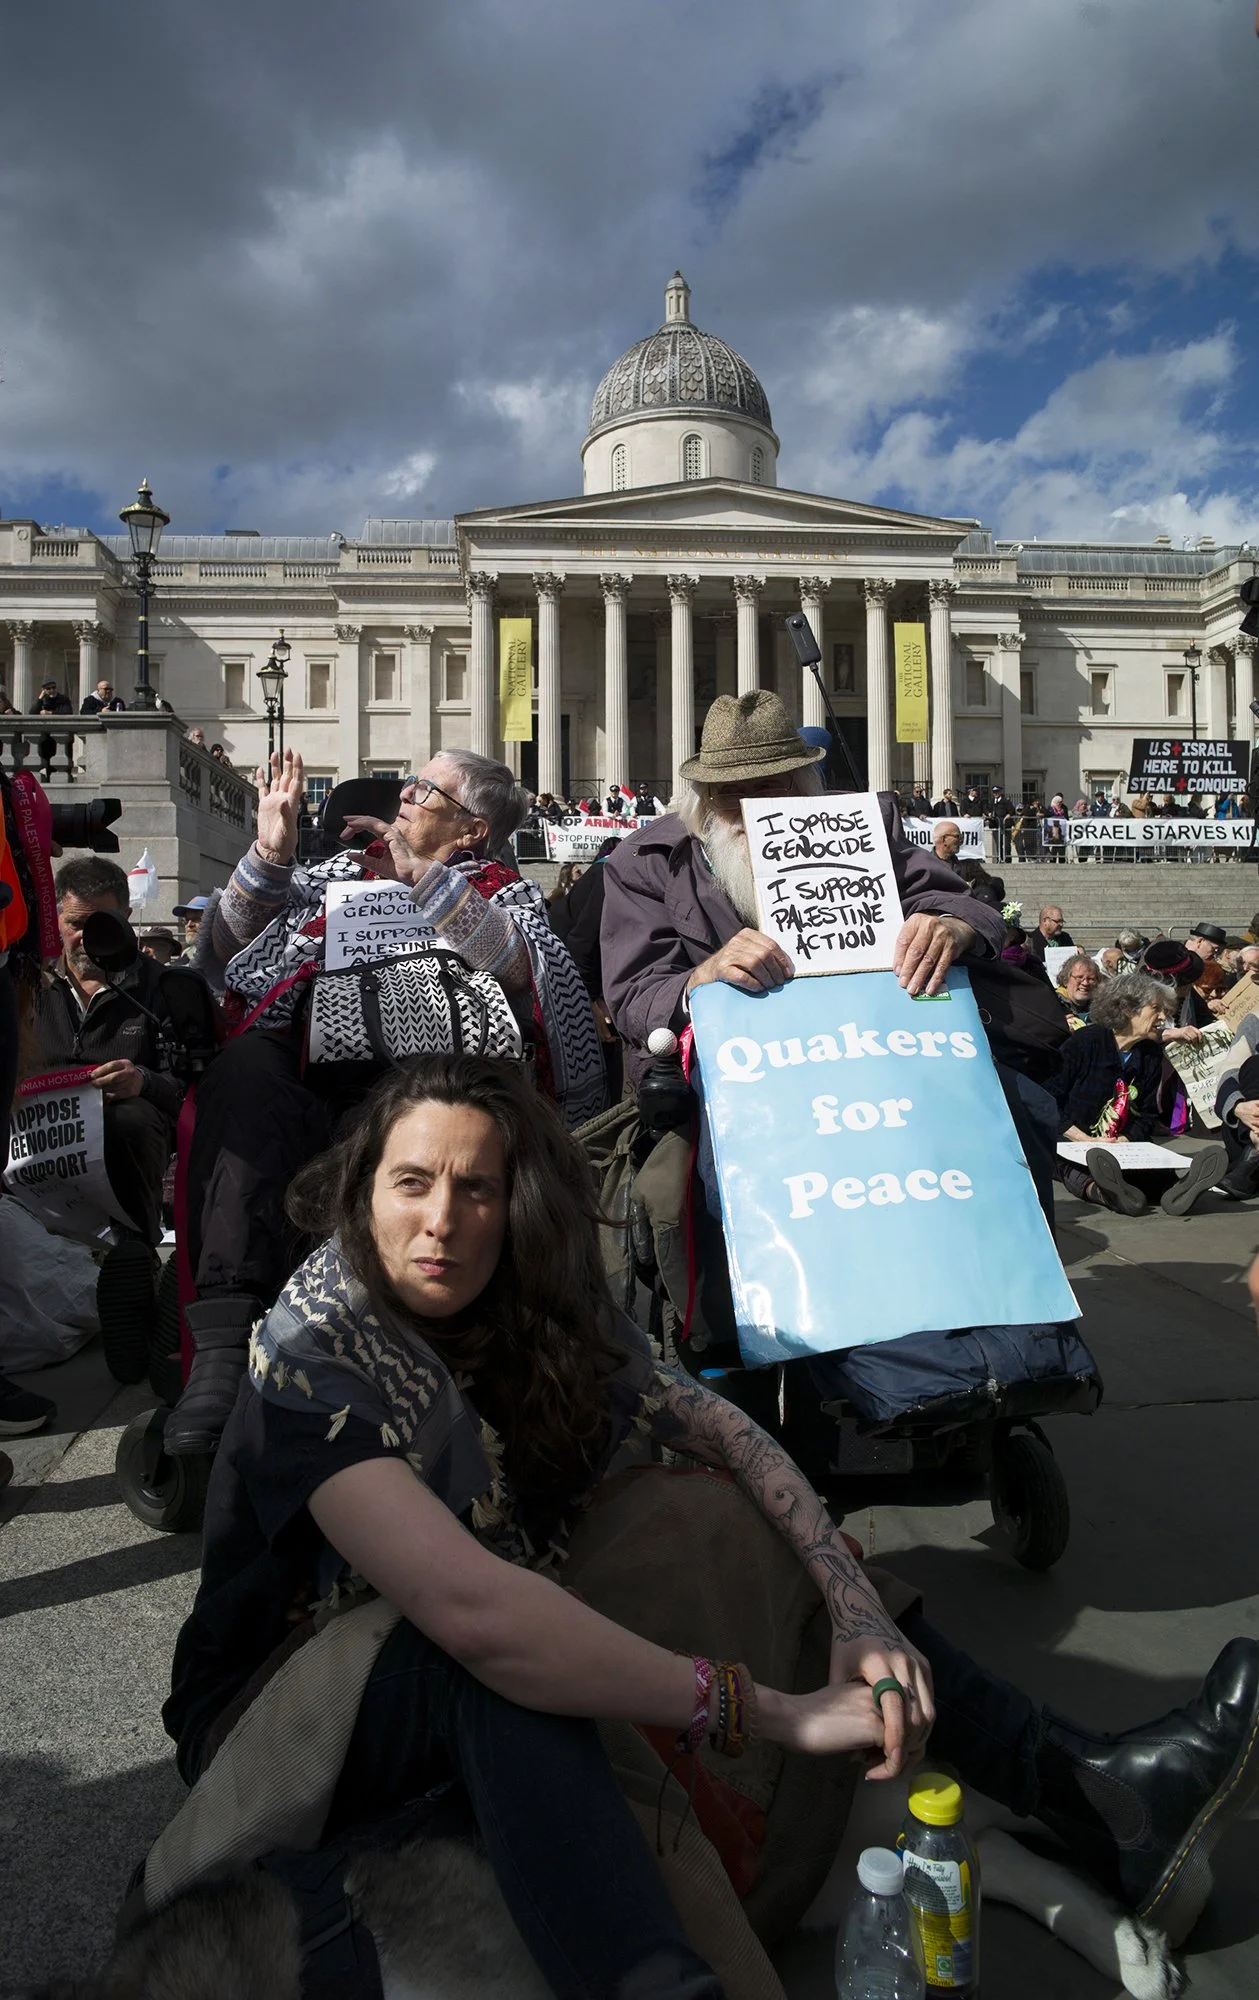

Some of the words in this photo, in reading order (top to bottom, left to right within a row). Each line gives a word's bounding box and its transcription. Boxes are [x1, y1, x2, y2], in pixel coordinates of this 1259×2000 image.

[577, 543, 617, 556] THE
[631, 544, 742, 558] NATIONAL
[757, 548, 850, 560] GALLERY
[508, 638, 516, 697] NATIONAL
[517, 639, 527, 697] GALLERY
[904, 641, 912, 697] NATIONAL
[913, 642, 923, 698] GALLERY
[1182, 742, 1232, 757] ISRAEL
[1142, 760, 1178, 774] HERE
[1183, 760, 1199, 774] TO
[1202, 761, 1236, 775] KILL
[1130, 777, 1175, 791] STEAL
[1187, 778, 1246, 793] CONQUER
[548, 817, 583, 827] STOP
[584, 818, 638, 829] ARMING
[757, 812, 785, 837] I
[789, 810, 869, 836] OPPOSE
[904, 830, 933, 845] HOL
[1068, 825, 1136, 840] ISRAEL
[1142, 826, 1227, 840] STARVES
[1232, 826, 1251, 840] KI
[558, 834, 583, 843] STOP
[573, 842, 588, 850] END
[762, 833, 875, 862] GENOCIDE
[14, 778, 27, 806] FREE
[21, 806, 48, 880] PALESTINIAN
[42, 882, 56, 950] HOSTAGES
[341, 894, 353, 904] I
[364, 891, 410, 902] OPPO
[767, 878, 790, 905] I
[795, 873, 886, 903] SUPPORT
[343, 904, 423, 919] GENOCID
[770, 901, 884, 935] PALESTINE
[338, 931, 349, 942] I
[795, 924, 876, 960] ACTION
[716, 1022, 978, 1083] Quakers
[48, 1070, 93, 1086] HOSTAGE
[16, 1096, 81, 1132] OPPOSE
[811, 1094, 913, 1135] for
[10, 1120, 85, 1161] GENOCIDE
[18, 1150, 89, 1186] SUPPORT
[783, 1169, 974, 1219] Peace
